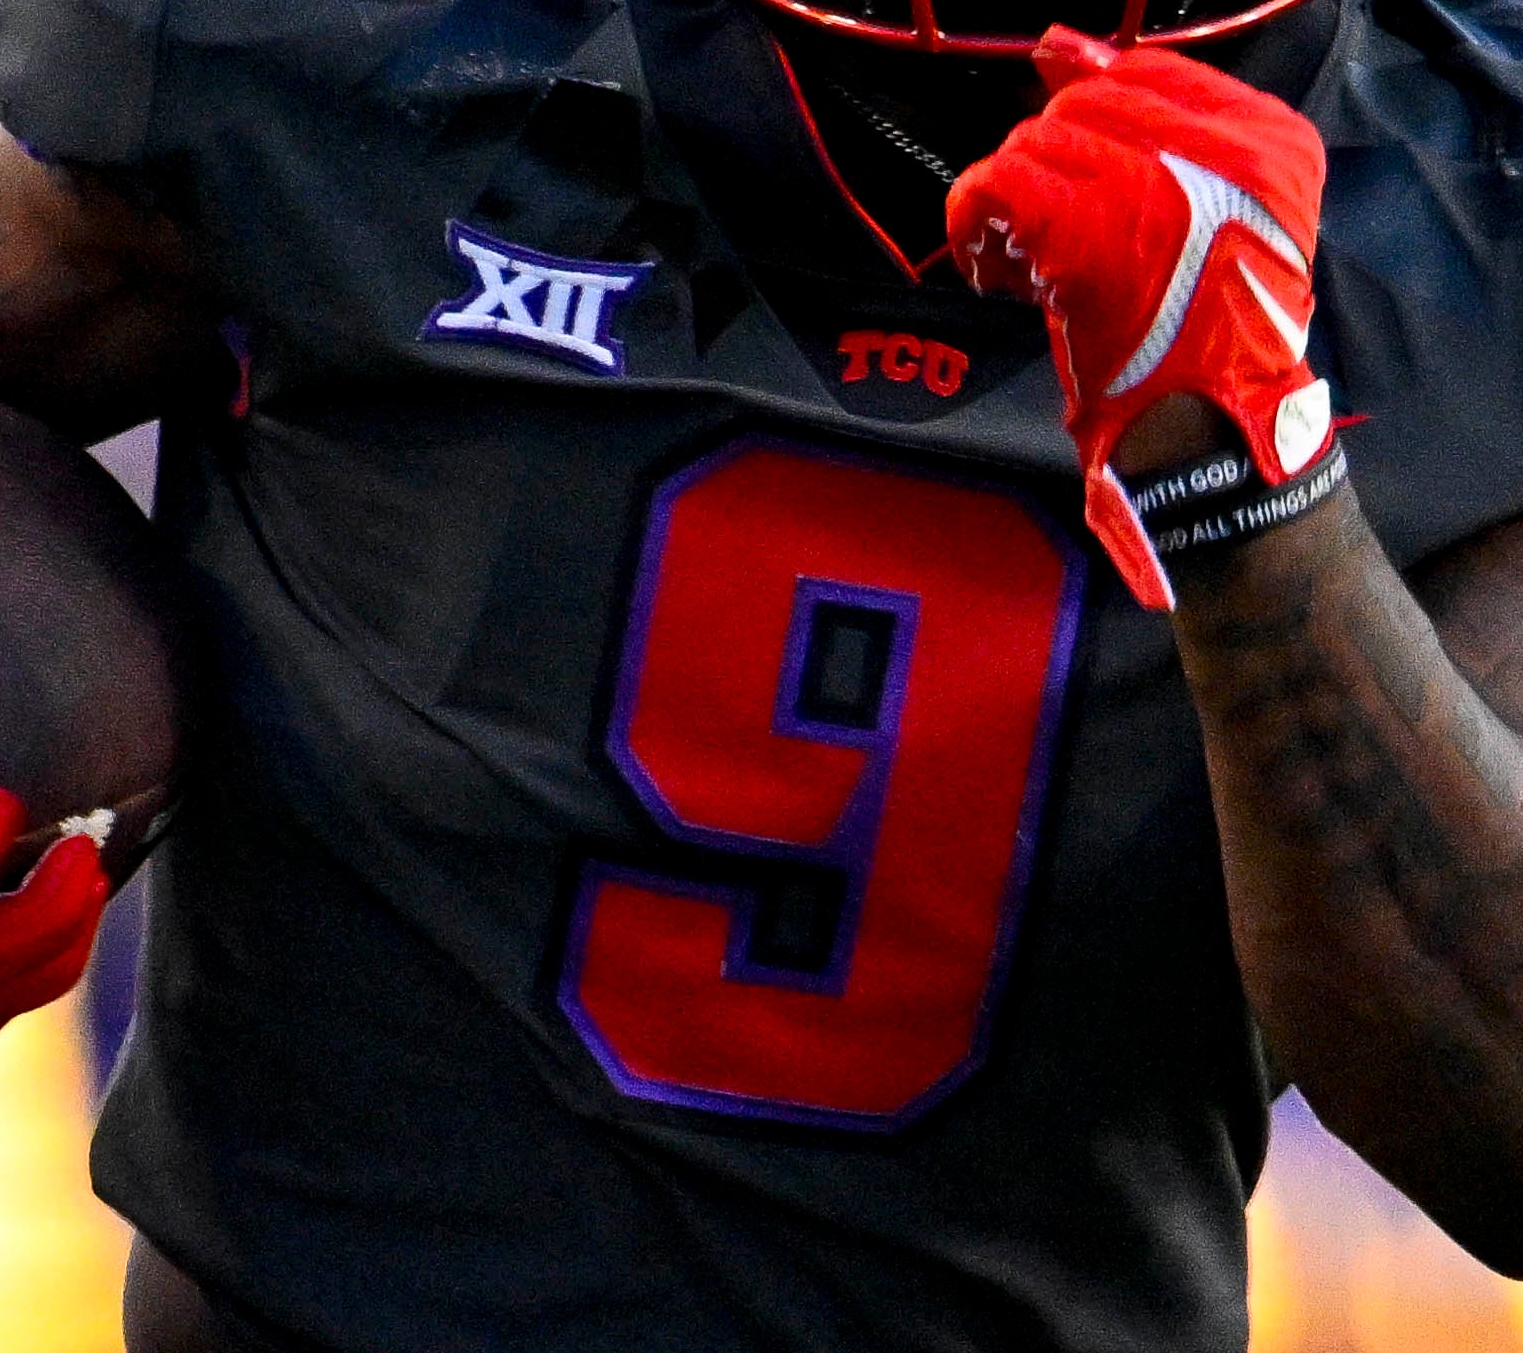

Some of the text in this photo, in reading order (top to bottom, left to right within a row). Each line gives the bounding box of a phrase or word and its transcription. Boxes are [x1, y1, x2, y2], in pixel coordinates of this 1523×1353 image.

[437, 238, 635, 366] XII
[838, 330, 969, 397] TCU
[1190, 458, 1239, 493] GOD
[1192, 514, 1232, 545] ALL
[1232, 485, 1308, 533] THINGS
[557, 431, 1087, 1134] 9
